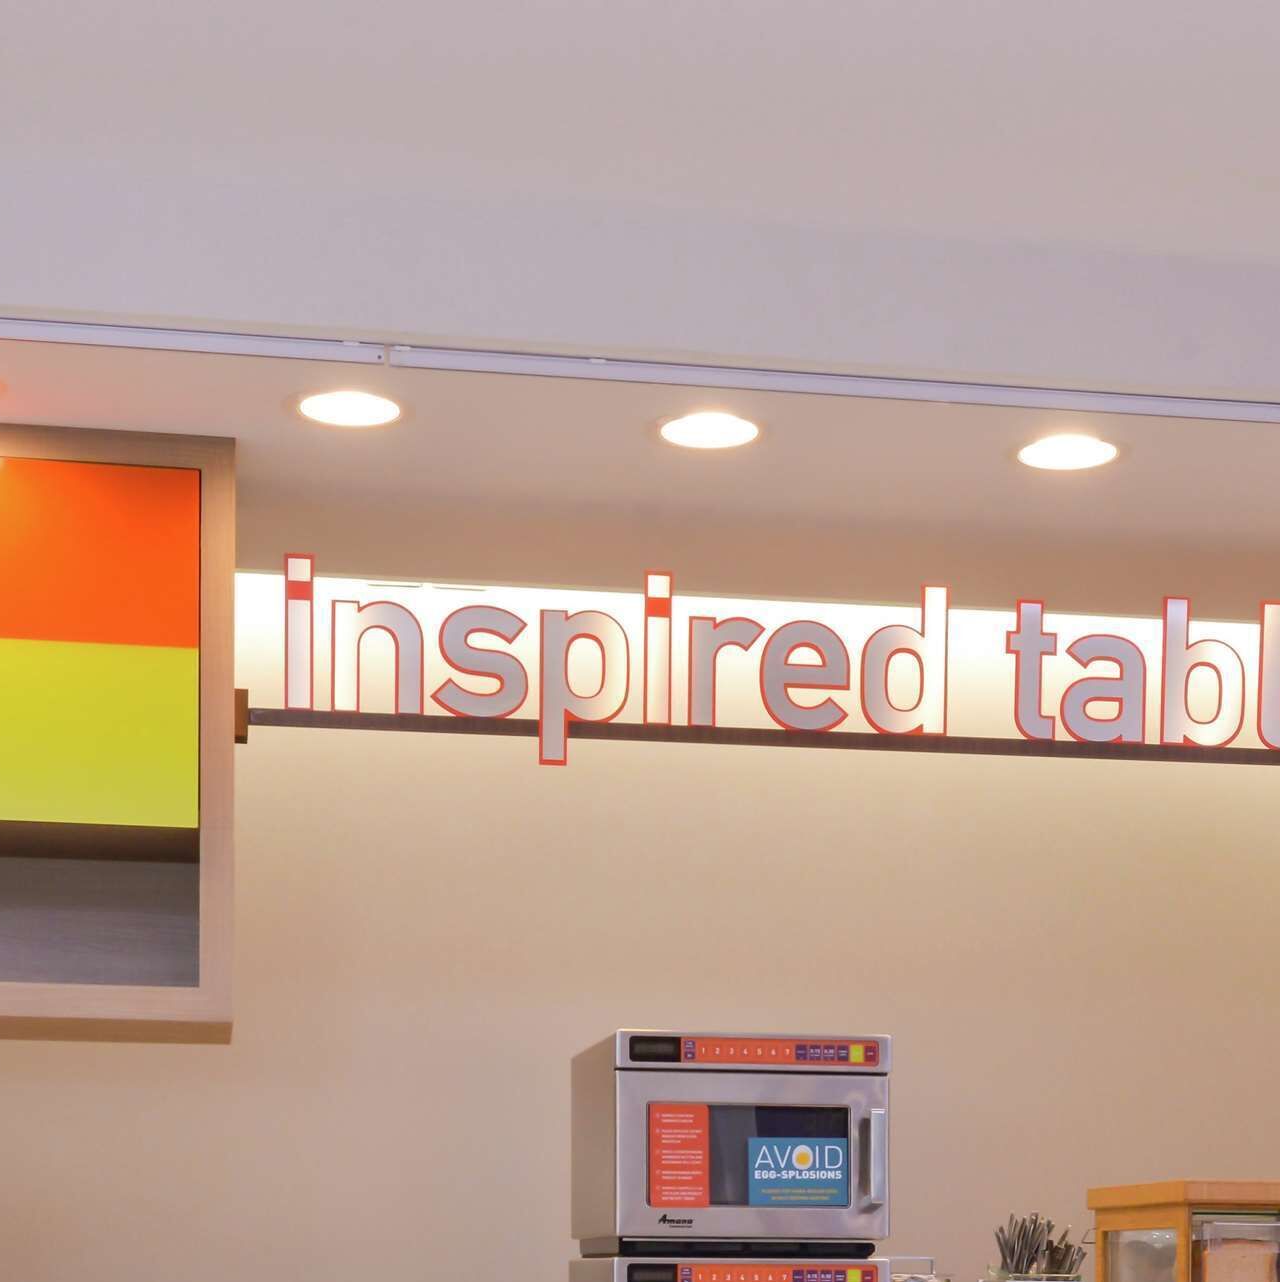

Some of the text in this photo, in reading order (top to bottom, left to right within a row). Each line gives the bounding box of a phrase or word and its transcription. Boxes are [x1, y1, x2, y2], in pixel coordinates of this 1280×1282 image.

[283, 552, 949, 766] inspired
[754, 1144, 843, 1170] AVOID
[754, 1170, 842, 1180] EGG-SPLOSIONS
